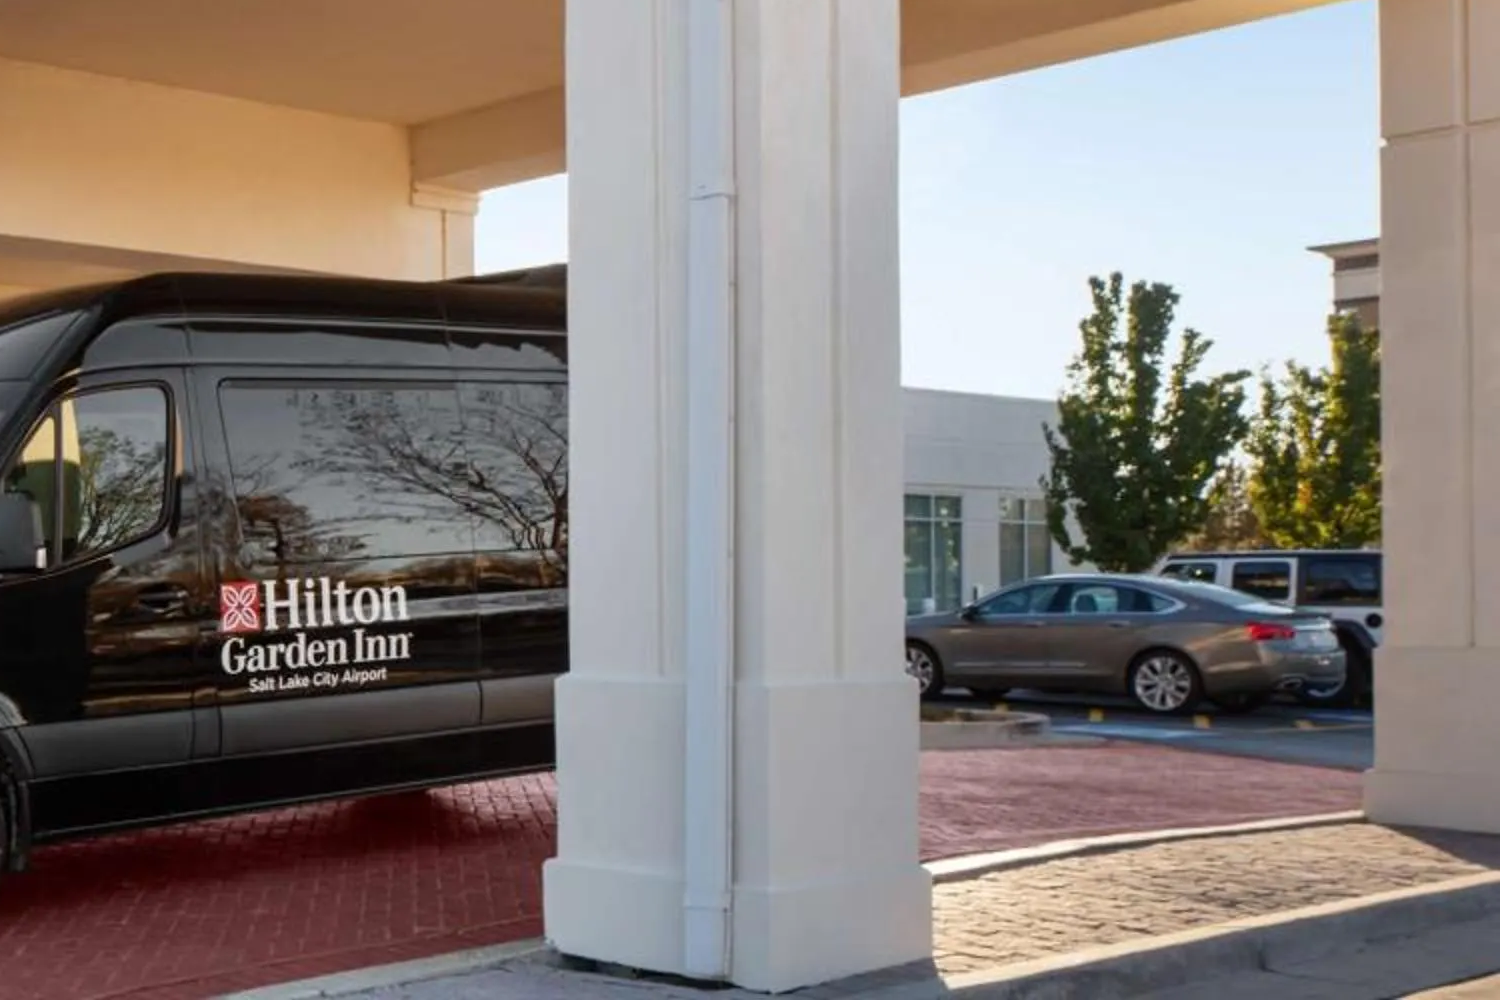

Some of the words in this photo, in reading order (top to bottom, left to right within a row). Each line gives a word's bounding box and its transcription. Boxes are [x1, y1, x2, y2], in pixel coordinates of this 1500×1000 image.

[262, 576, 411, 631] Hilton
[221, 632, 348, 675] Garden
[353, 628, 411, 663] Inn
[249, 677, 275, 693] Salt
[279, 674, 310, 689] Lake
[313, 671, 339, 687] City
[342, 666, 387, 686] Airport
